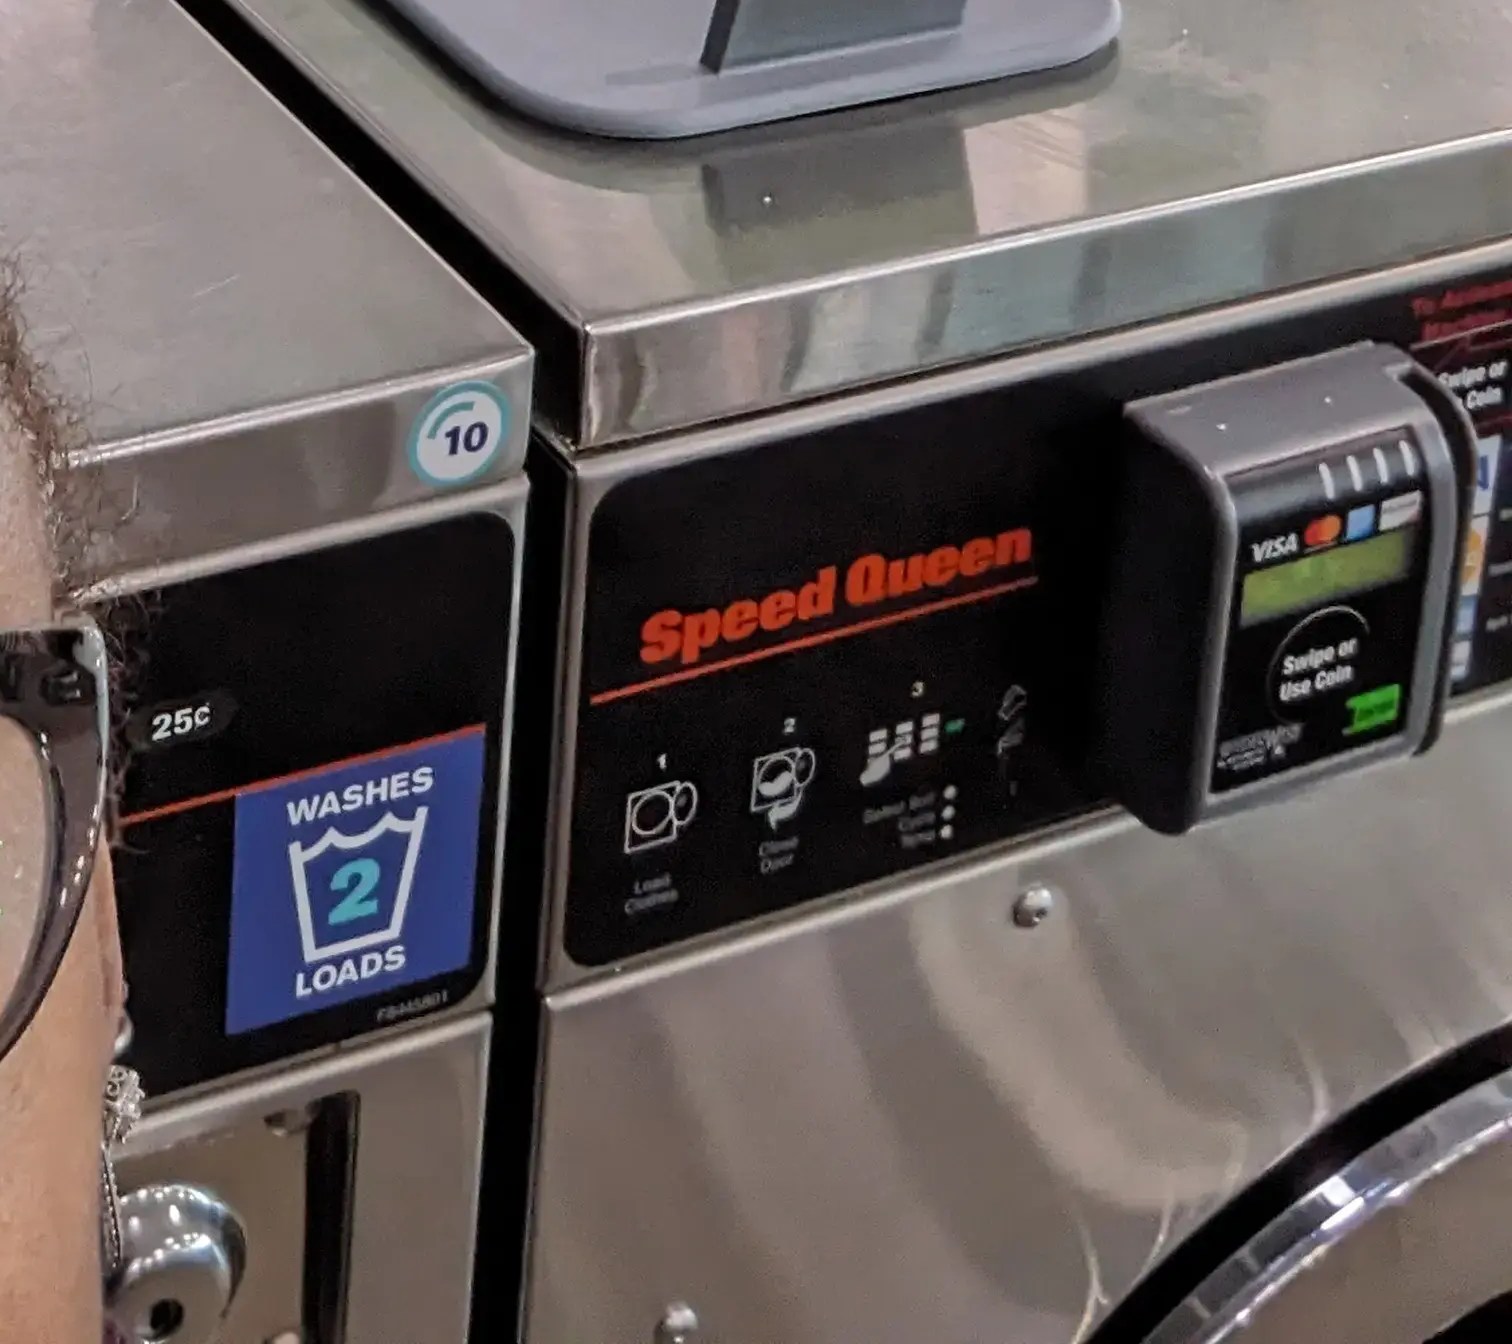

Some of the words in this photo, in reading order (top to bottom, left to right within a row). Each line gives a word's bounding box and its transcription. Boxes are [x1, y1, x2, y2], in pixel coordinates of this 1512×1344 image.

[443, 422, 490, 457] 10
[1251, 532, 1299, 563] VISA
[639, 564, 836, 666] Speed
[844, 526, 1033, 608] Queen
[1282, 645, 1335, 675] Swipe
[1338, 638, 1358, 655] or
[910, 681, 926, 699] 3
[1279, 678, 1311, 702] Use
[1314, 664, 1354, 690] Coin
[782, 717, 798, 735] 2
[656, 752, 669, 771] 1
[286, 765, 436, 829] WASHES
[326, 856, 382, 928] 2
[294, 944, 407, 999] LOADS
